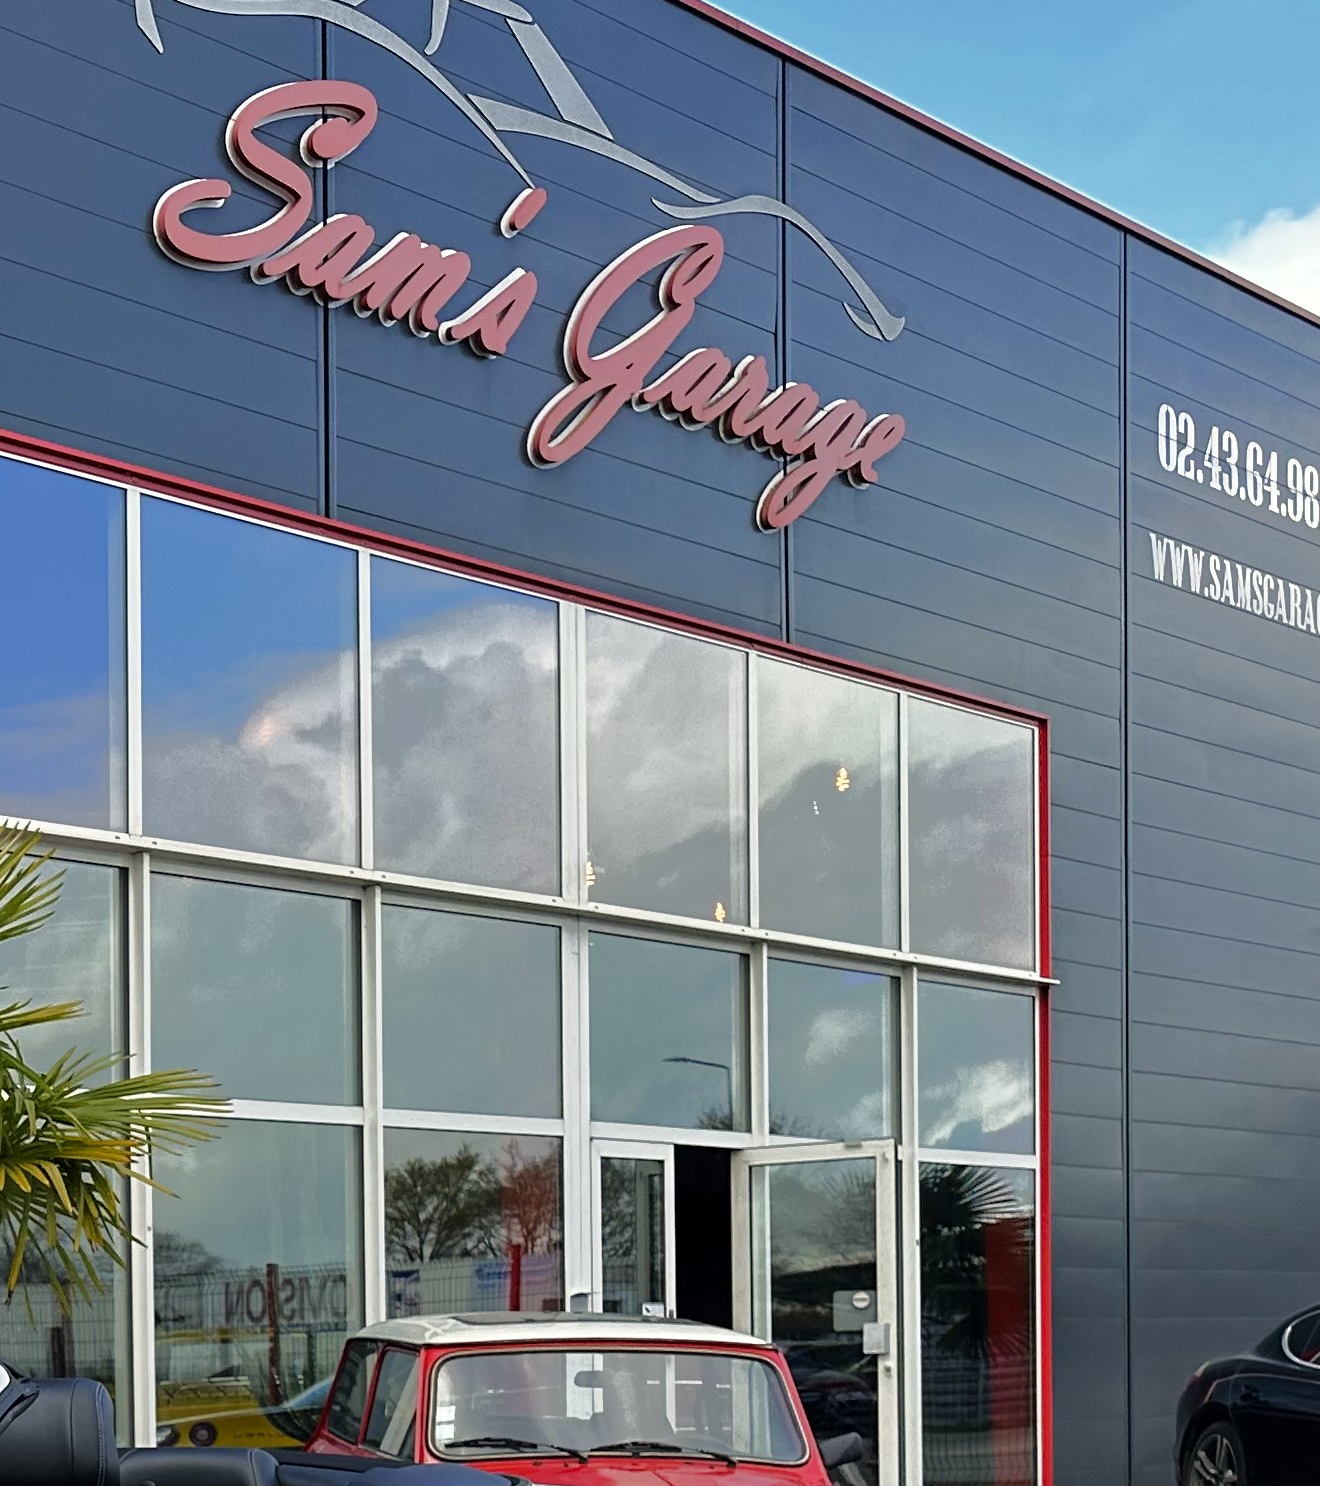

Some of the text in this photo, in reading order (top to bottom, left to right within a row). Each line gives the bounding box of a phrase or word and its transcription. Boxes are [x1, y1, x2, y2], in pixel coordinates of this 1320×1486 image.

[153, 78, 907, 533] Sam's Garage
[1158, 403, 1319, 528] 02.43.64.98
[1149, 532, 1320, 634] WWW.SAMSGARA
